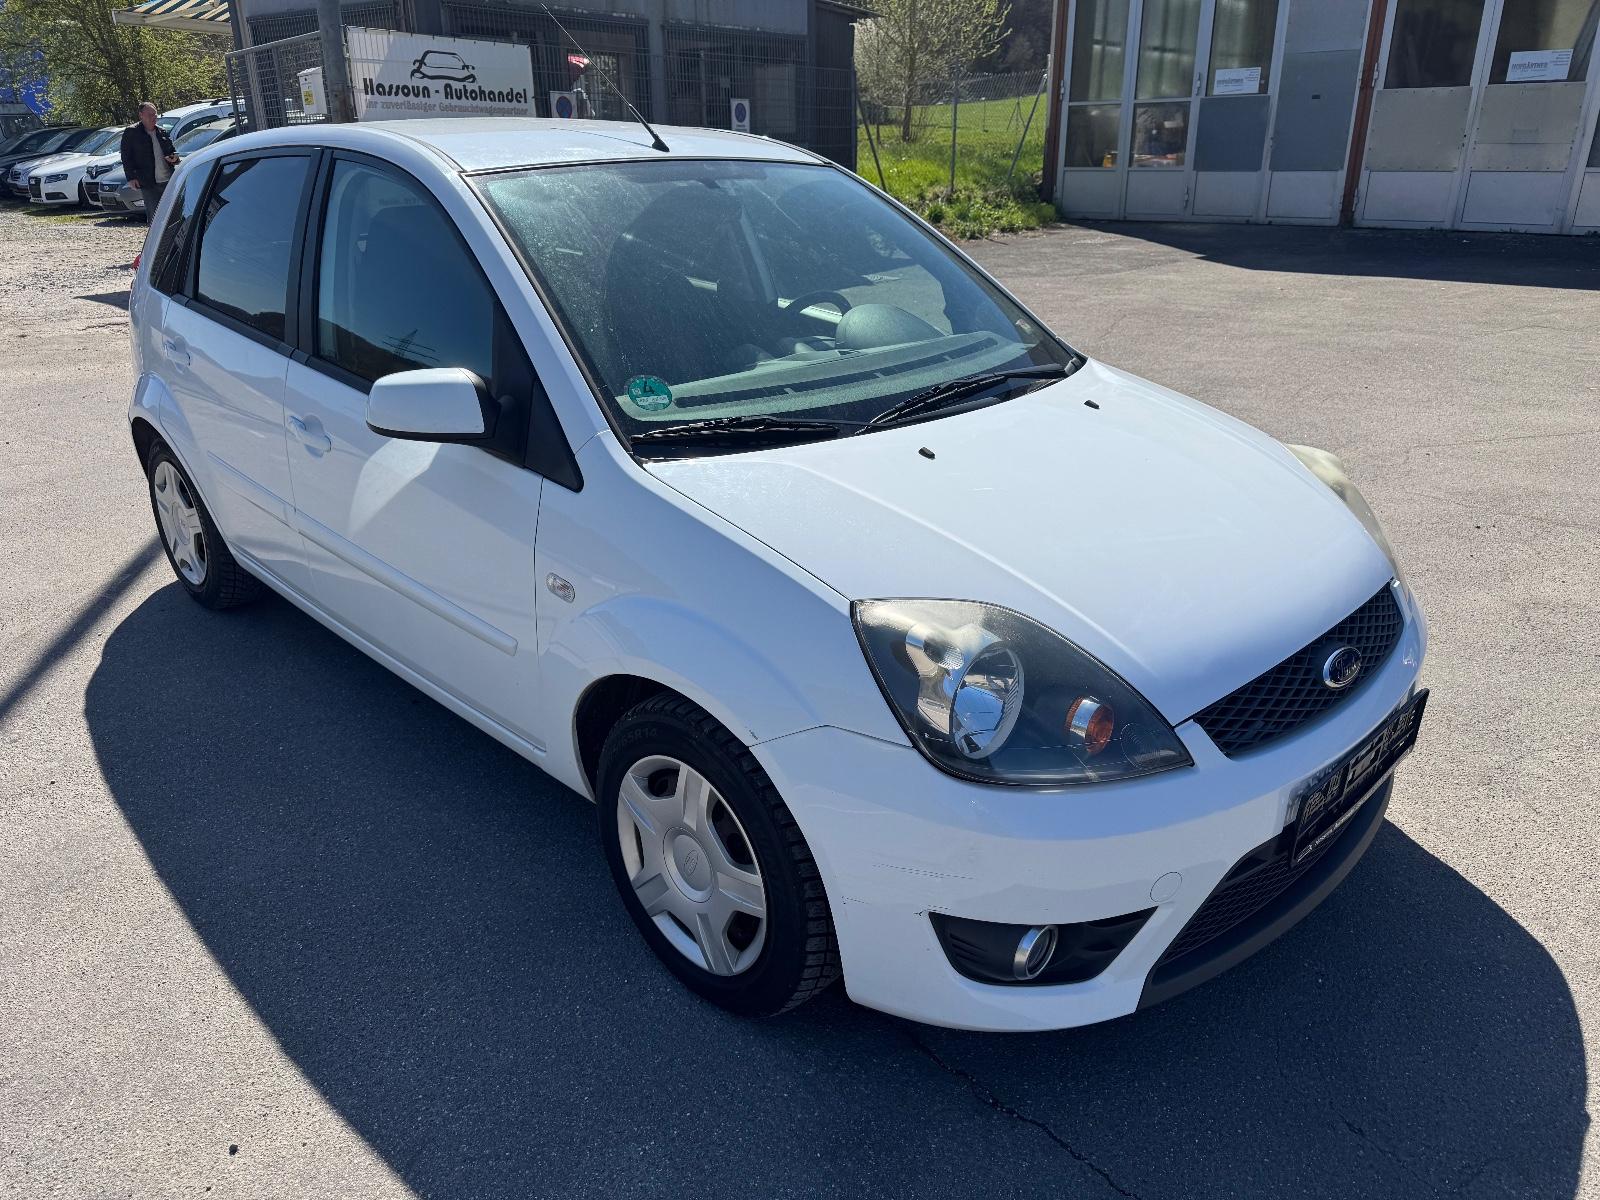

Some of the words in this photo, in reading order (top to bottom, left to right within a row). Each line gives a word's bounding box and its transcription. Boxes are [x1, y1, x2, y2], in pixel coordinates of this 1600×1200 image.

[363, 78, 431, 99] Hassoun
[444, 83, 528, 104] Autohandel
[643, 380, 656, 395] 4
